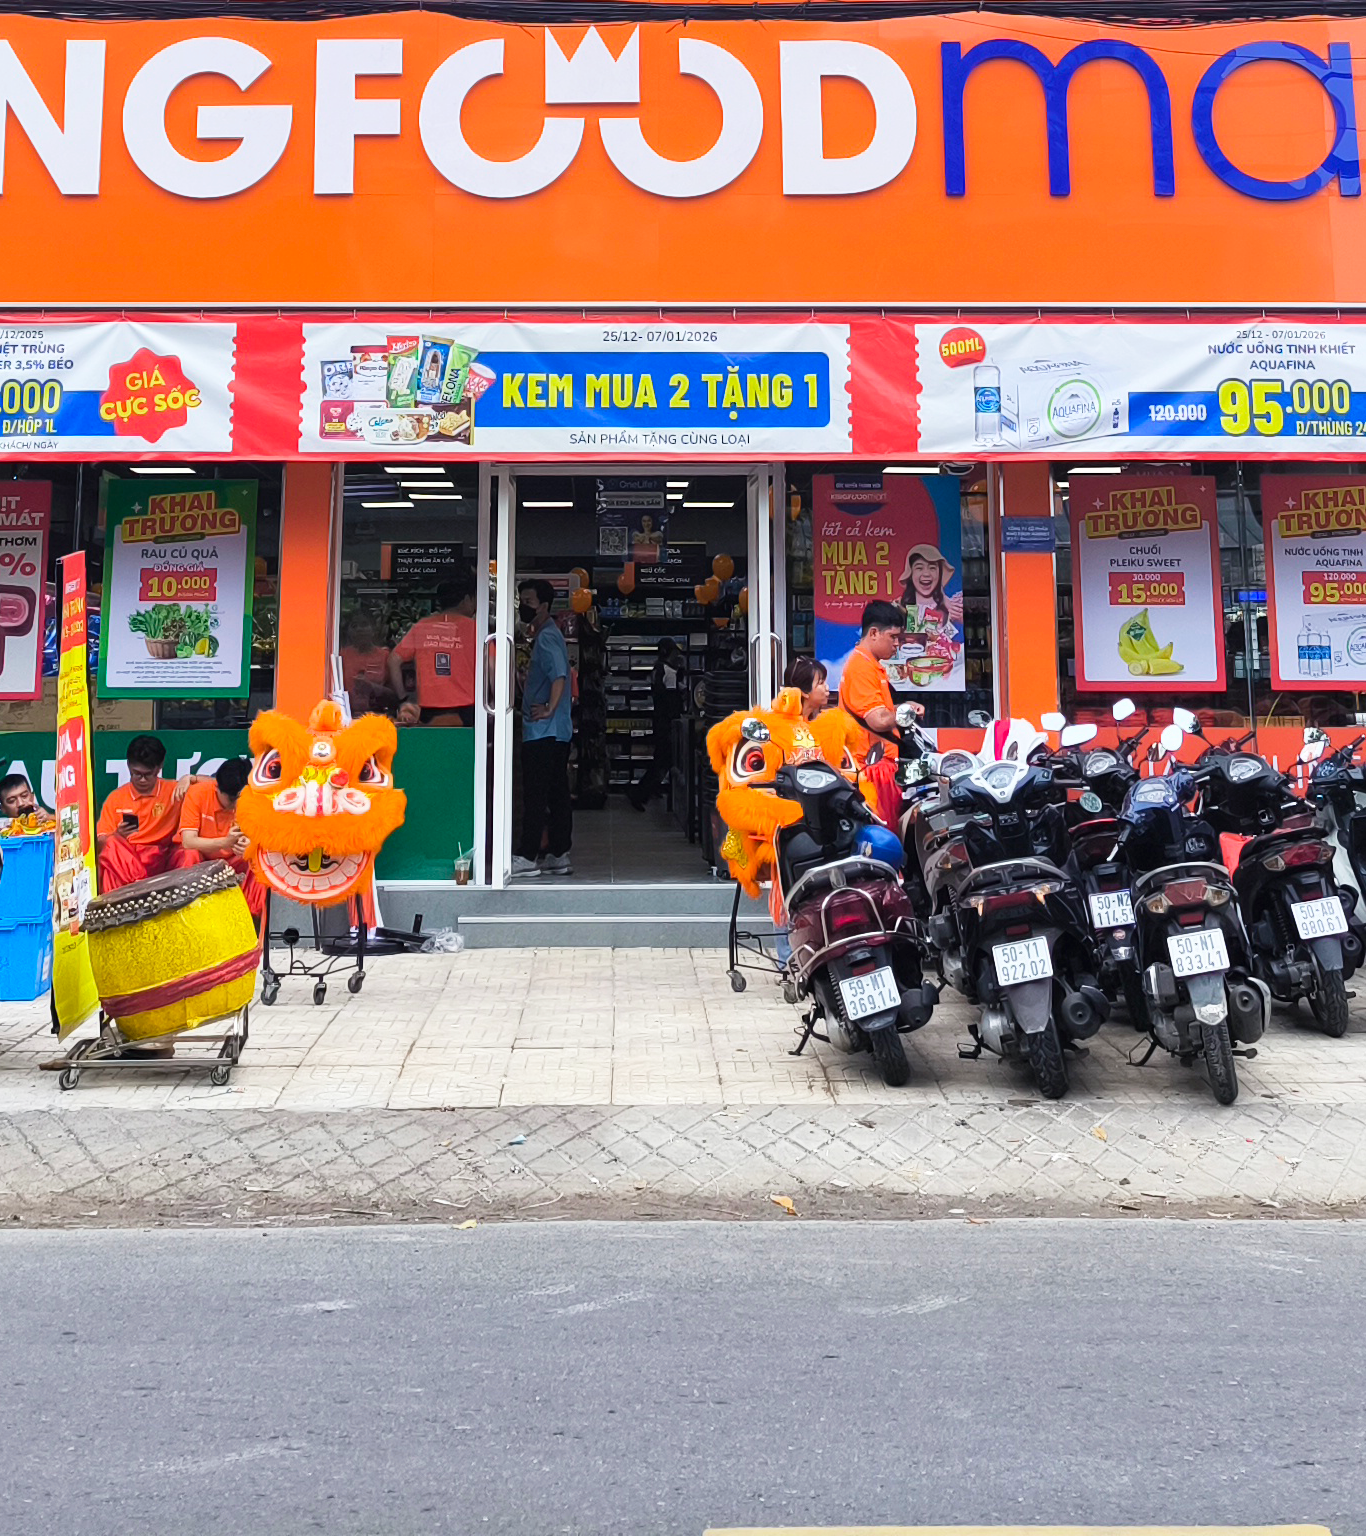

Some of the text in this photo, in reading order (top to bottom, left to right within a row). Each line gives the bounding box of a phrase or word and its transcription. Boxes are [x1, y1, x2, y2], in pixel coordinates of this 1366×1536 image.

[646, 330, 718, 343] 07/01/2026
[941, 337, 983, 357] 500ML
[1207, 340, 1244, 356] NƯỚC
[47, 358, 74, 371] BÉO
[1249, 359, 1316, 372] AQUAFINA
[125, 364, 167, 392] GIÁ
[99, 384, 203, 423] CỰC SỐC
[502, 365, 818, 421] KEM MUA 2 TẶNG 1
[1217, 377, 1352, 437] 95.000
[569, 430, 751, 448] SẢN PHẨM CÙNG LOẠI
[149, 492, 216, 515] KHAI
[1110, 488, 1174, 511] KHAI
[1303, 487, 1366, 511] KHAI
[124, 510, 239, 537] TRƯƠNG
[1087, 506, 1199, 533] TRƯƠNG
[141, 548, 167, 560] RAU
[821, 540, 890, 565] MUA 2
[1109, 558, 1182, 567] PLEIKU SWEET
[1315, 558, 1363, 568] AQUAFINA
[147, 576, 211, 598] 10.000
[821, 567, 893, 599] TẶNG 1
[1117, 582, 1179, 604] 15.000
[1096, 893, 1132, 911] 50-N2
[1302, 914, 1345, 937] 980.61
[1000, 940, 1040, 963] 50-Y1
[1175, 934, 1216, 957] 50-N1
[1000, 957, 1049, 982] 922.02
[1175, 950, 1231, 973] 833.41
[848, 988, 898, 1017] 369.14
